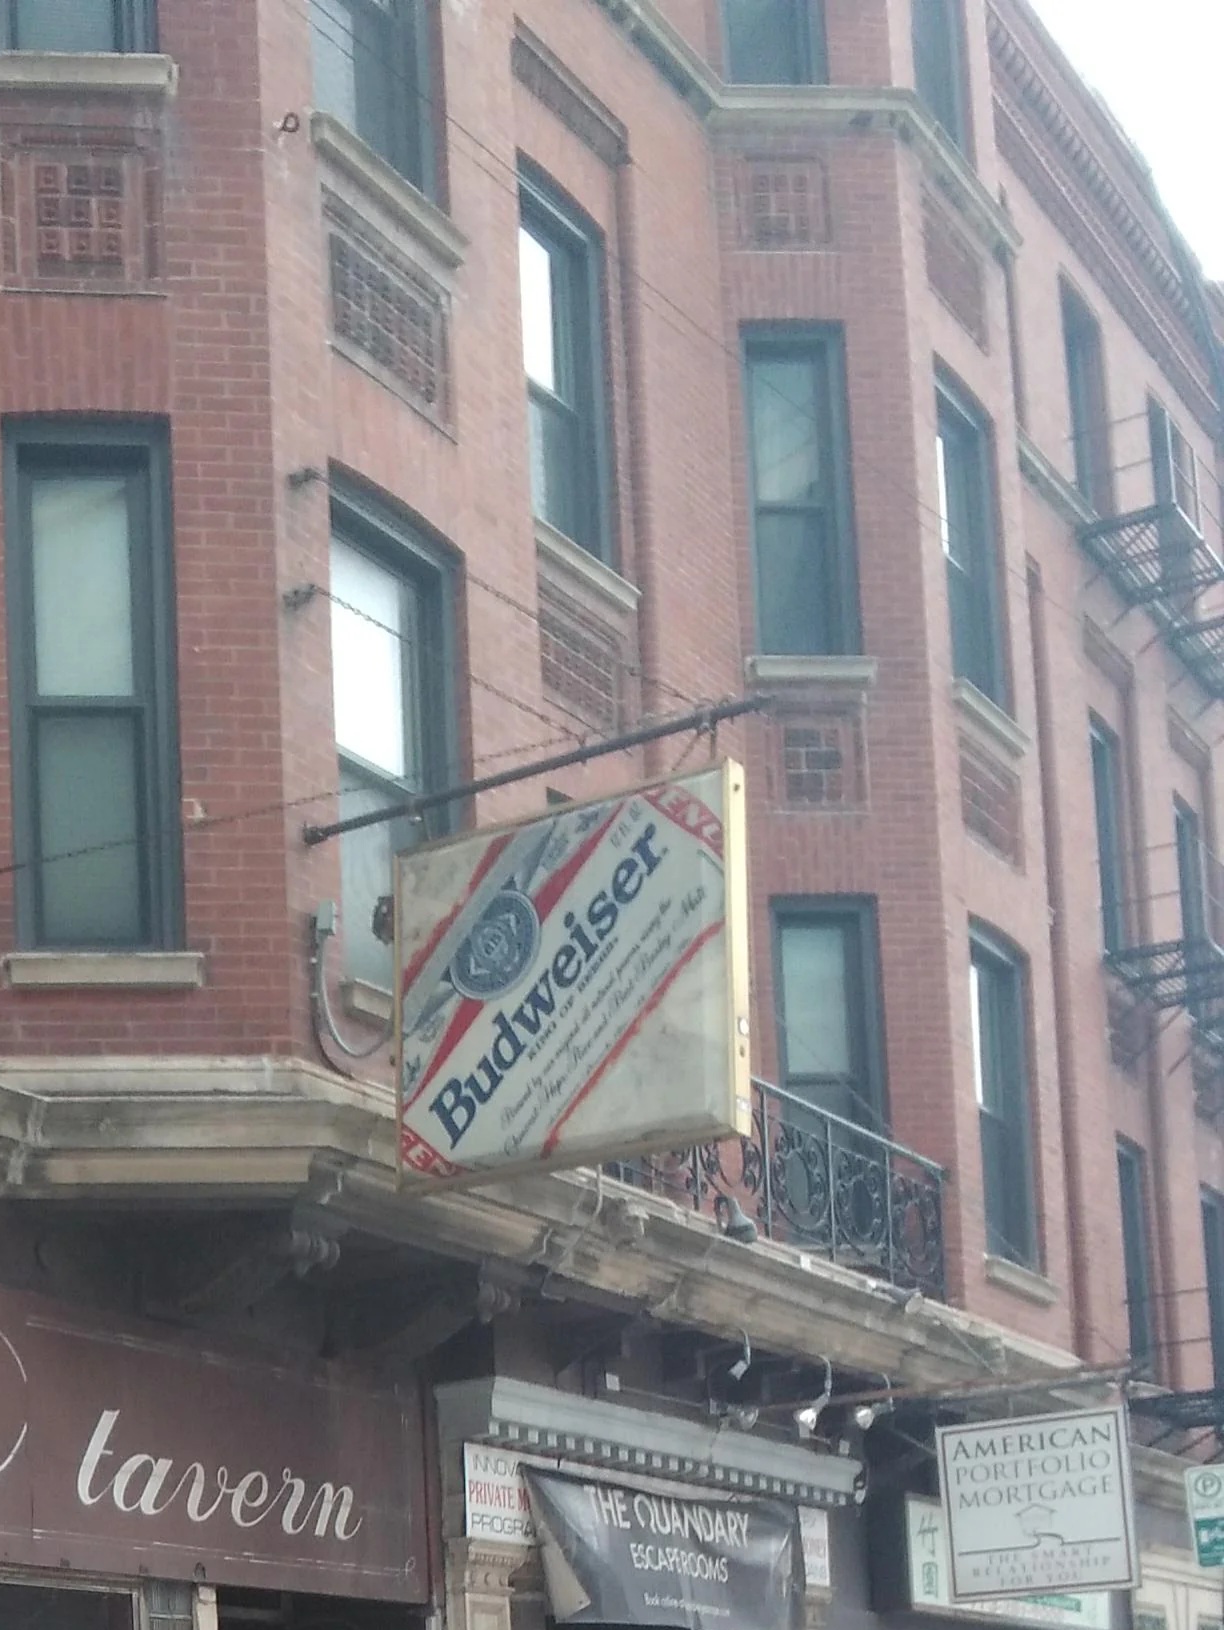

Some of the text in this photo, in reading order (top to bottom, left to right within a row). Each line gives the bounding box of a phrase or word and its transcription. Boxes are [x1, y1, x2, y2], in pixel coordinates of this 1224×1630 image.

[429, 822, 664, 1149] Budweiser
[952, 1423, 1112, 1462] AMERICAN
[77, 1409, 363, 1541] tavern
[955, 1450, 1111, 1486] PORTFOLIO
[468, 1480, 515, 1509] PRIVATE
[958, 1474, 1116, 1511] MORTGAGE
[471, 1512, 537, 1538] PROGRA
[583, 1484, 750, 1548] THE QUANDARY
